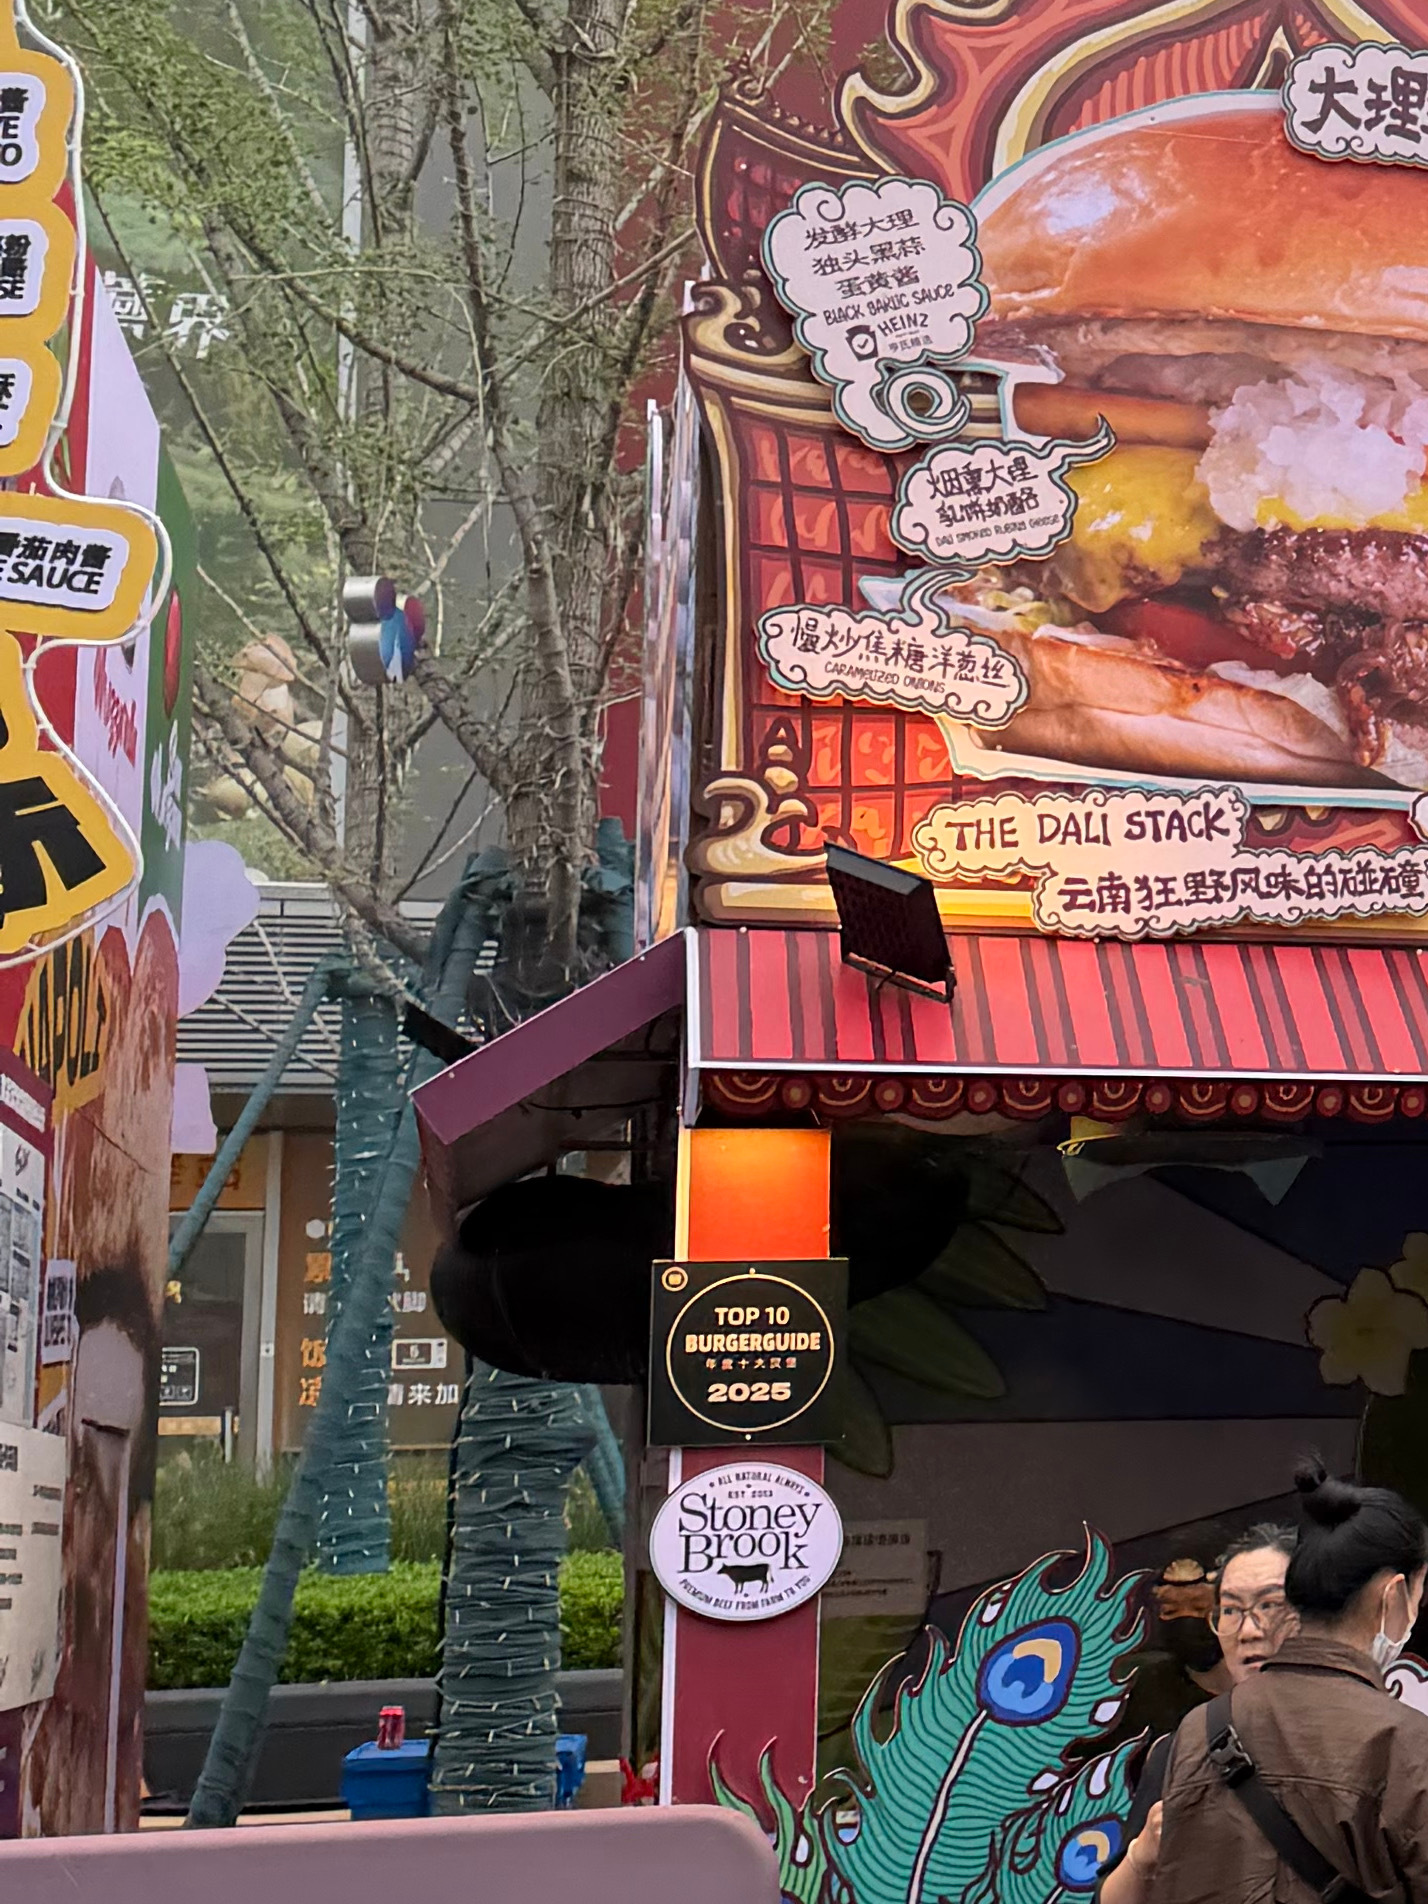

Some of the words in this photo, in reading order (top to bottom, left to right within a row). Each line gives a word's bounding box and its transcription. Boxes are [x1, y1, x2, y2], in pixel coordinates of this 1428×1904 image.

[804, 208, 919, 251] 发酵大理
[812, 236, 926, 276] 独头黑蒜
[835, 265, 920, 299] 蛋黄酱
[823, 303, 865, 326] BLACK
[911, 283, 954, 304] SAUCE
[877, 313, 929, 337] HEINZ
[926, 455, 1038, 500] 烟熏大理
[7, 560, 105, 595] SAUCE
[790, 617, 1011, 689] 慢炒焦糖洋葱丝
[945, 815, 1019, 850] THE
[1037, 810, 1112, 846] DALI
[1123, 801, 1231, 843] STACK
[714, 1307, 760, 1326] TOP
[765, 1306, 790, 1325] 10
[685, 1332, 821, 1353] BURGERGUIDE
[707, 1381, 792, 1403] 2025
[678, 1492, 823, 1539] Stoney
[677, 1531, 809, 1574] Brook
